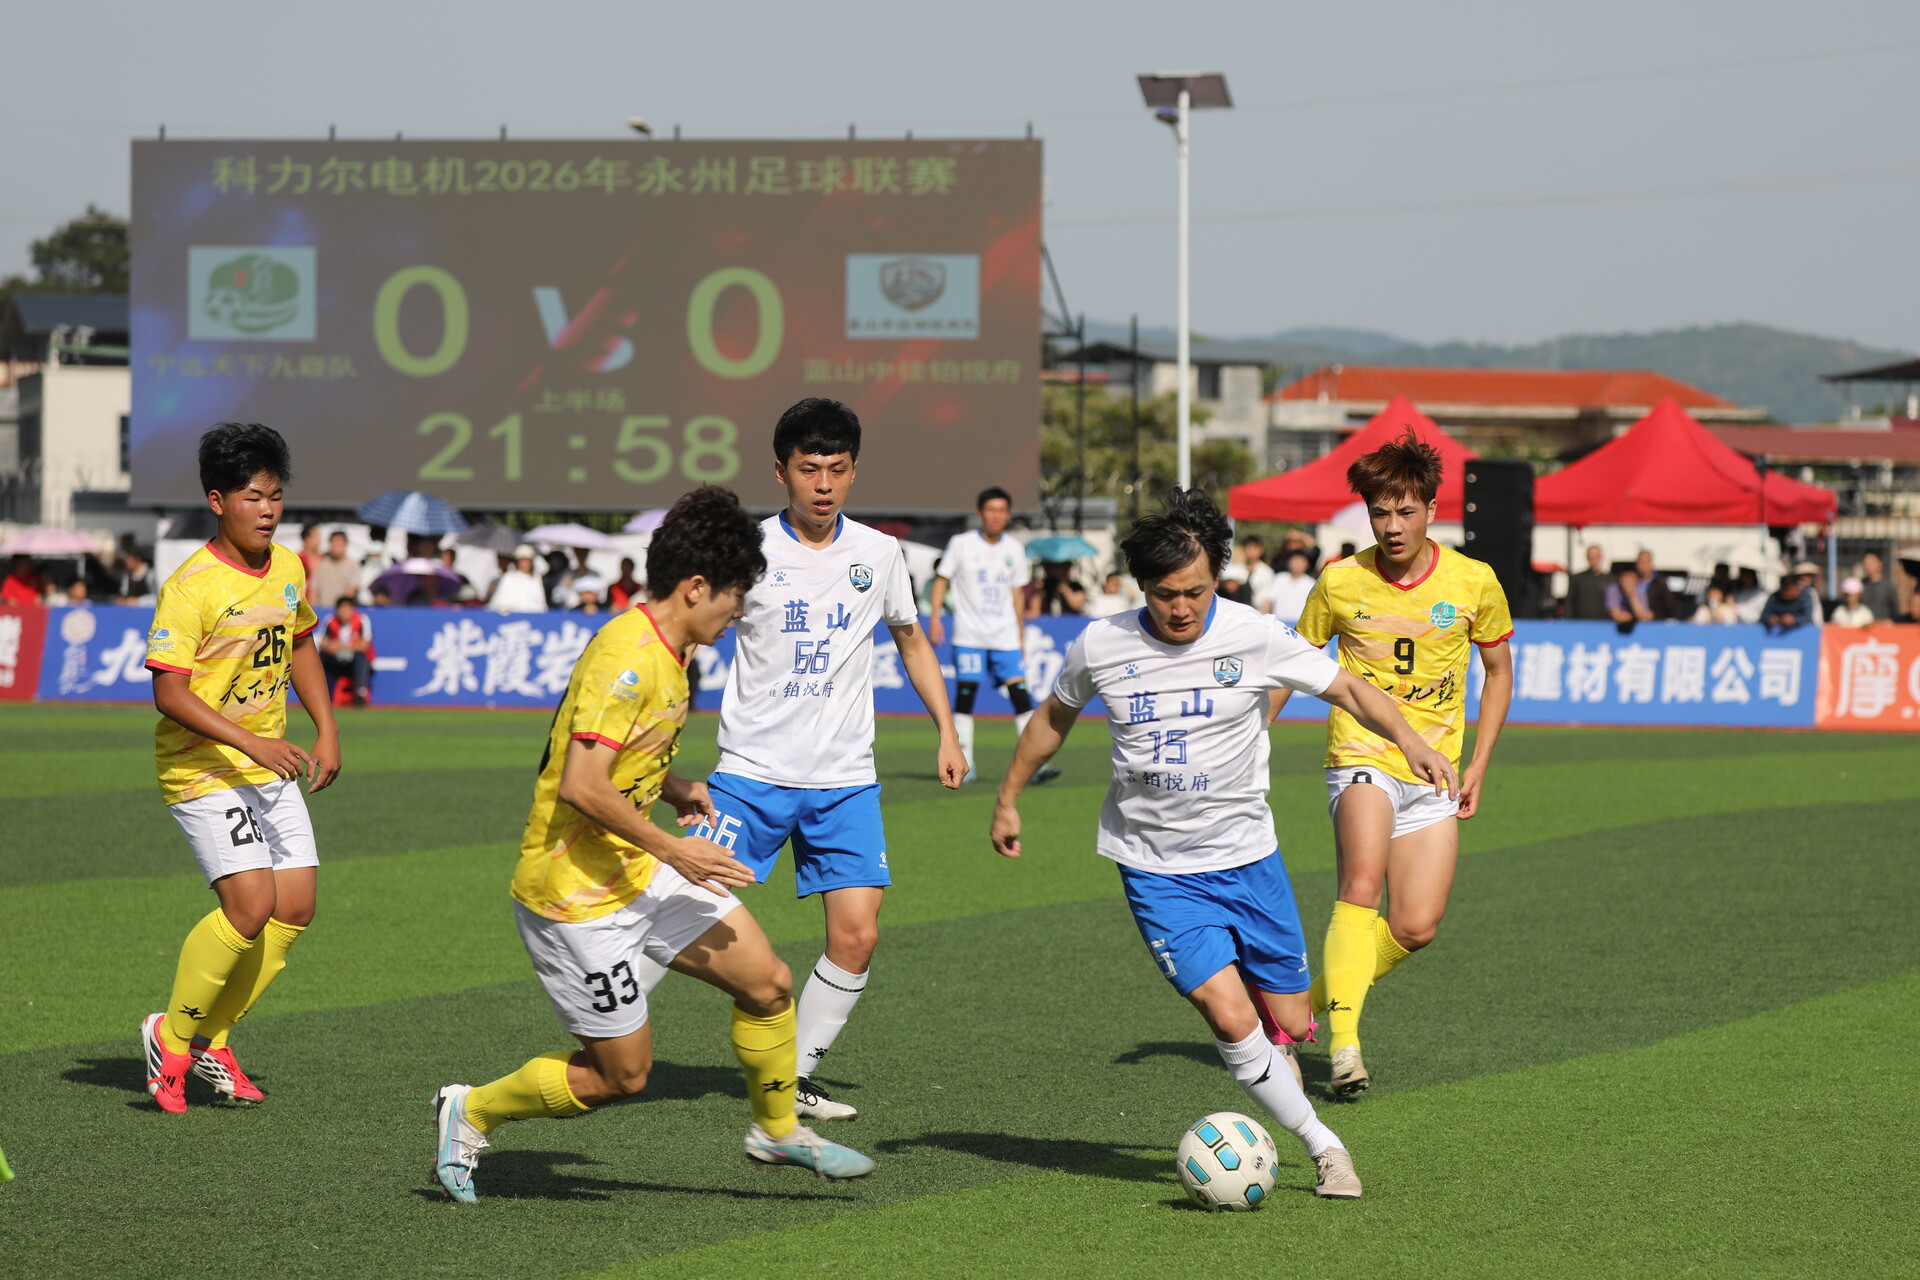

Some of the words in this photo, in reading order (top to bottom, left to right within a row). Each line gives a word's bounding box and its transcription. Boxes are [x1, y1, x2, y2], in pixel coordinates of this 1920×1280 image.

[212, 155, 958, 196] 科力尔电机2026年永州足球联赛
[373, 265, 469, 378] 0
[687, 266, 785, 379] 0
[531, 387, 626, 414] 上半场
[780, 599, 851, 633] 蓝山
[253, 624, 286, 668] 26
[792, 639, 831, 674] 66
[1394, 637, 1414, 675] 9
[1472, 641, 1801, 706] 建材有限公司
[1125, 689, 1214, 726] 蓝山
[1148, 730, 1188, 764] 15
[1142, 772, 1210, 792] 铂悦府
[585, 960, 639, 1013] 33
